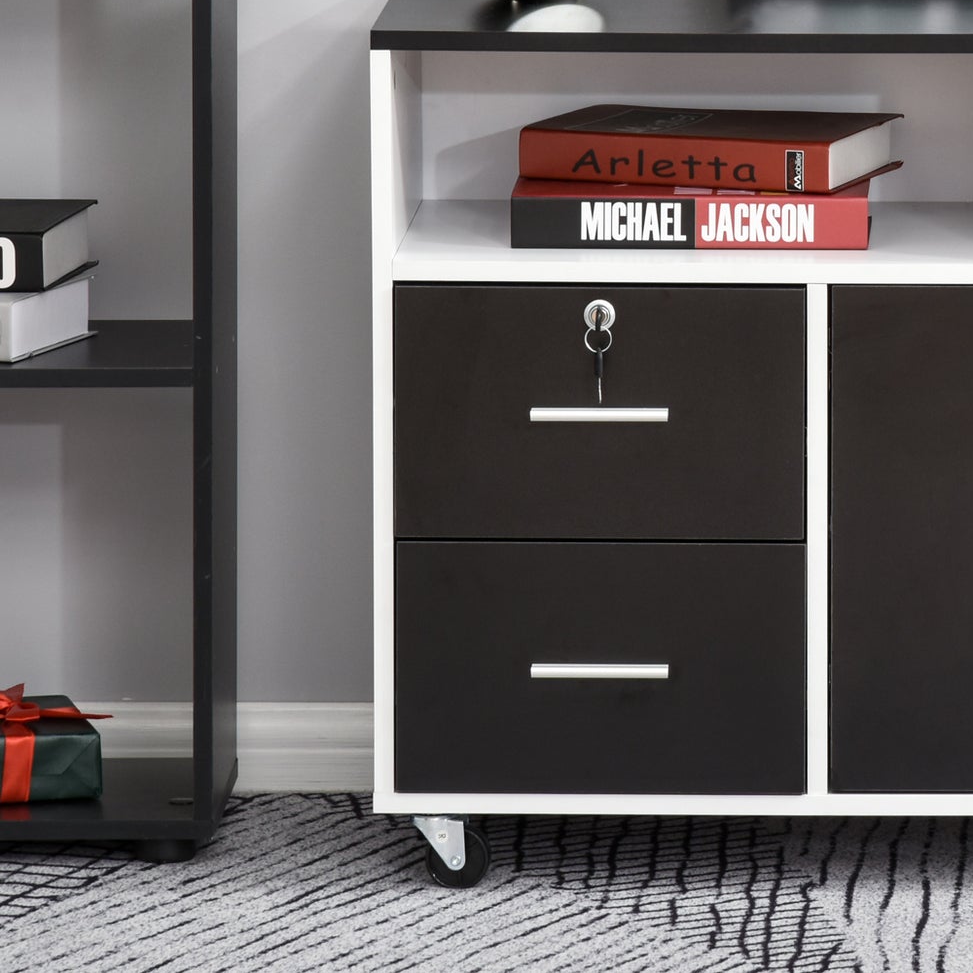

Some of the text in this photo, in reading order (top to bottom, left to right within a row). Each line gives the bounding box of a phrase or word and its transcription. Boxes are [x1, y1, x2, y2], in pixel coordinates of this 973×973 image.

[571, 148, 757, 183] Arletta
[580, 201, 815, 243] MICHAEL JACKSON
